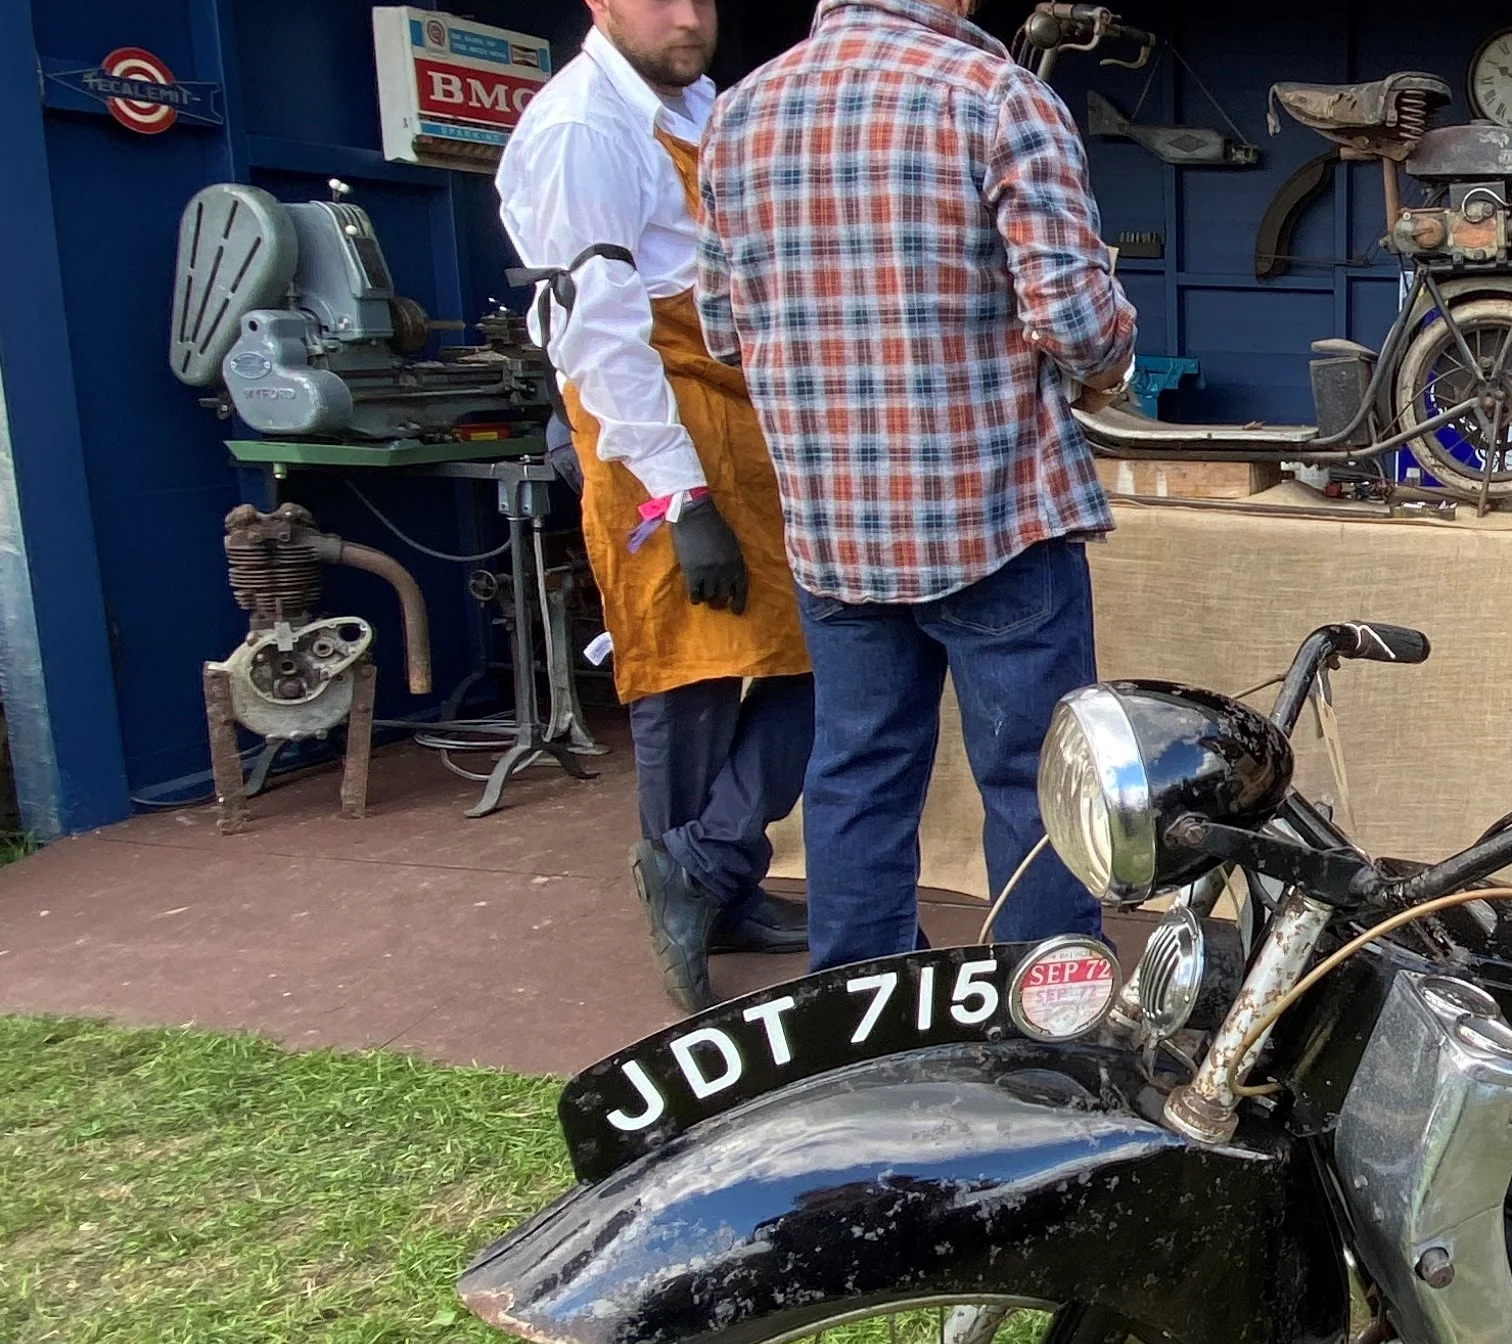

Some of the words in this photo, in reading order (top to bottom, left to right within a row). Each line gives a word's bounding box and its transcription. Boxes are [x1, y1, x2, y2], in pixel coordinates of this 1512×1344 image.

[1029, 962, 1079, 986] SEP
[1086, 958, 1112, 980] 72
[606, 996, 796, 1132] JDT
[846, 959, 998, 1044] 715
